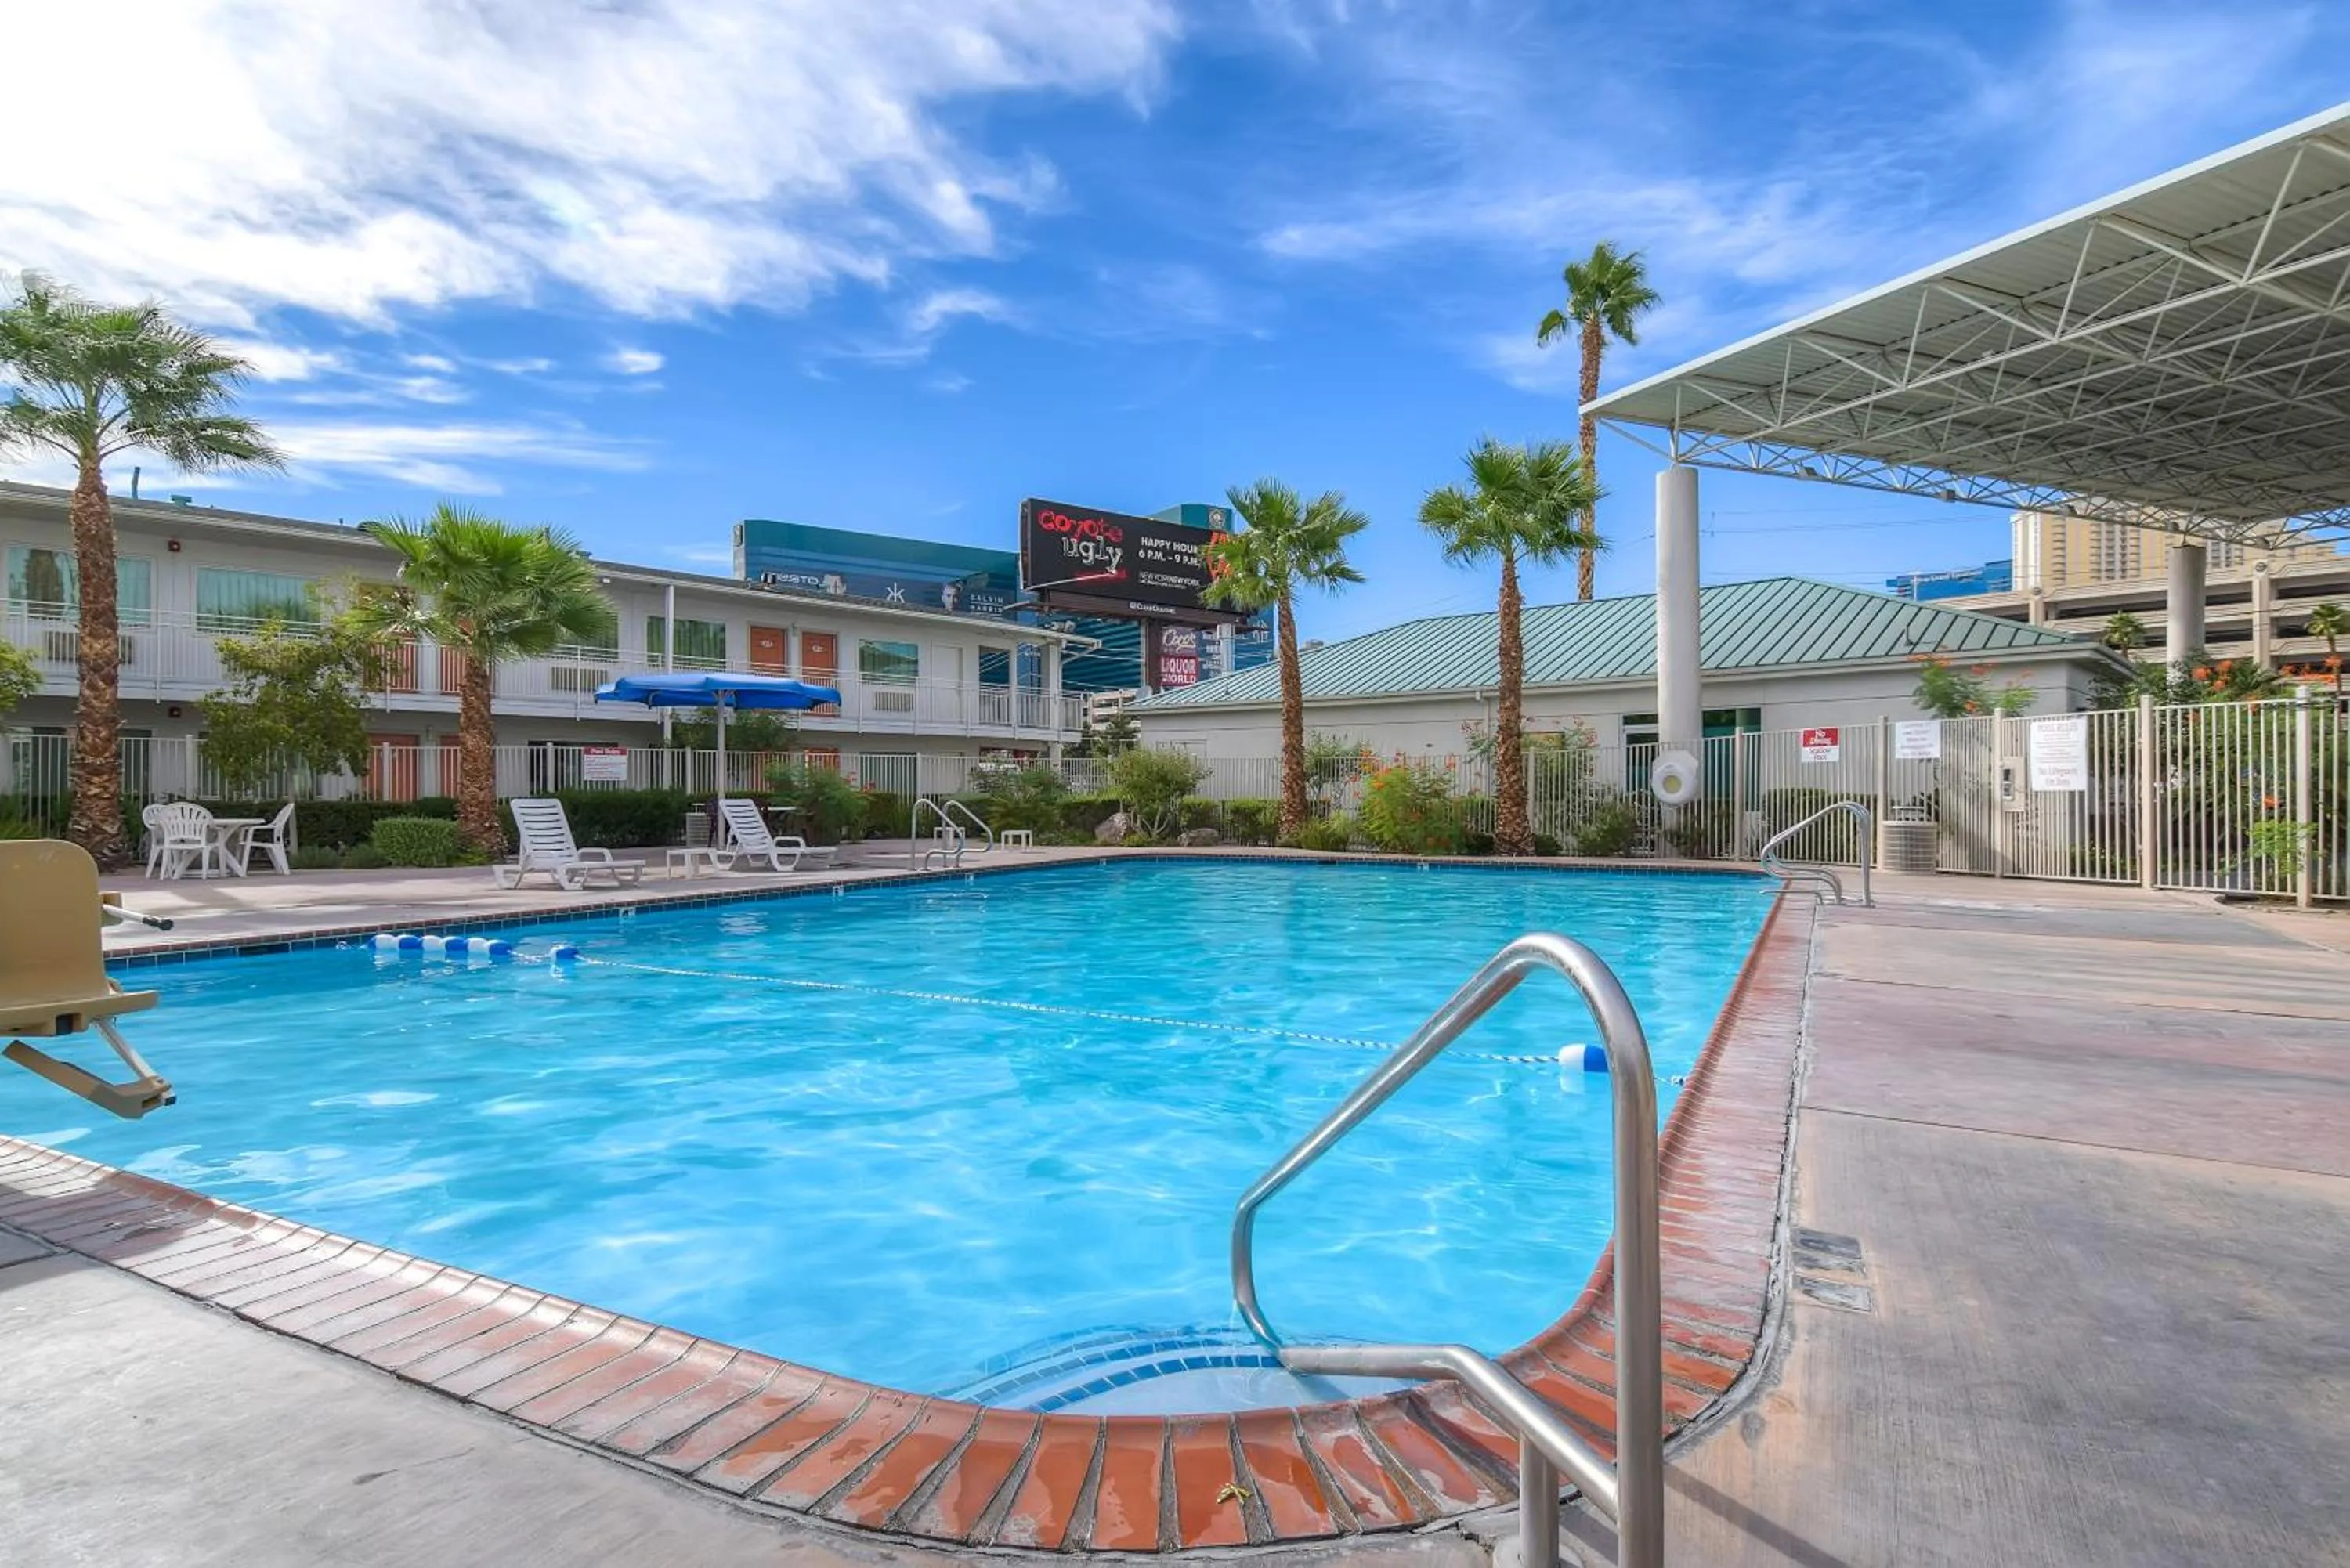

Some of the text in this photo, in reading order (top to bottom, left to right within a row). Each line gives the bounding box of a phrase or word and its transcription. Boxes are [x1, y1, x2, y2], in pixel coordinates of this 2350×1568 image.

[1038, 509, 1123, 542] Coyote
[1141, 537, 1198, 553] HAPPY HOUR
[1061, 536, 1123, 576] ugly
[1138, 549, 1145, 558] 6
[1147, 550, 1166, 561] P.M.
[1175, 554, 1181, 563] 9
[1162, 657, 1196, 674] LIQUOR
[1162, 674, 1196, 685] WORLD
